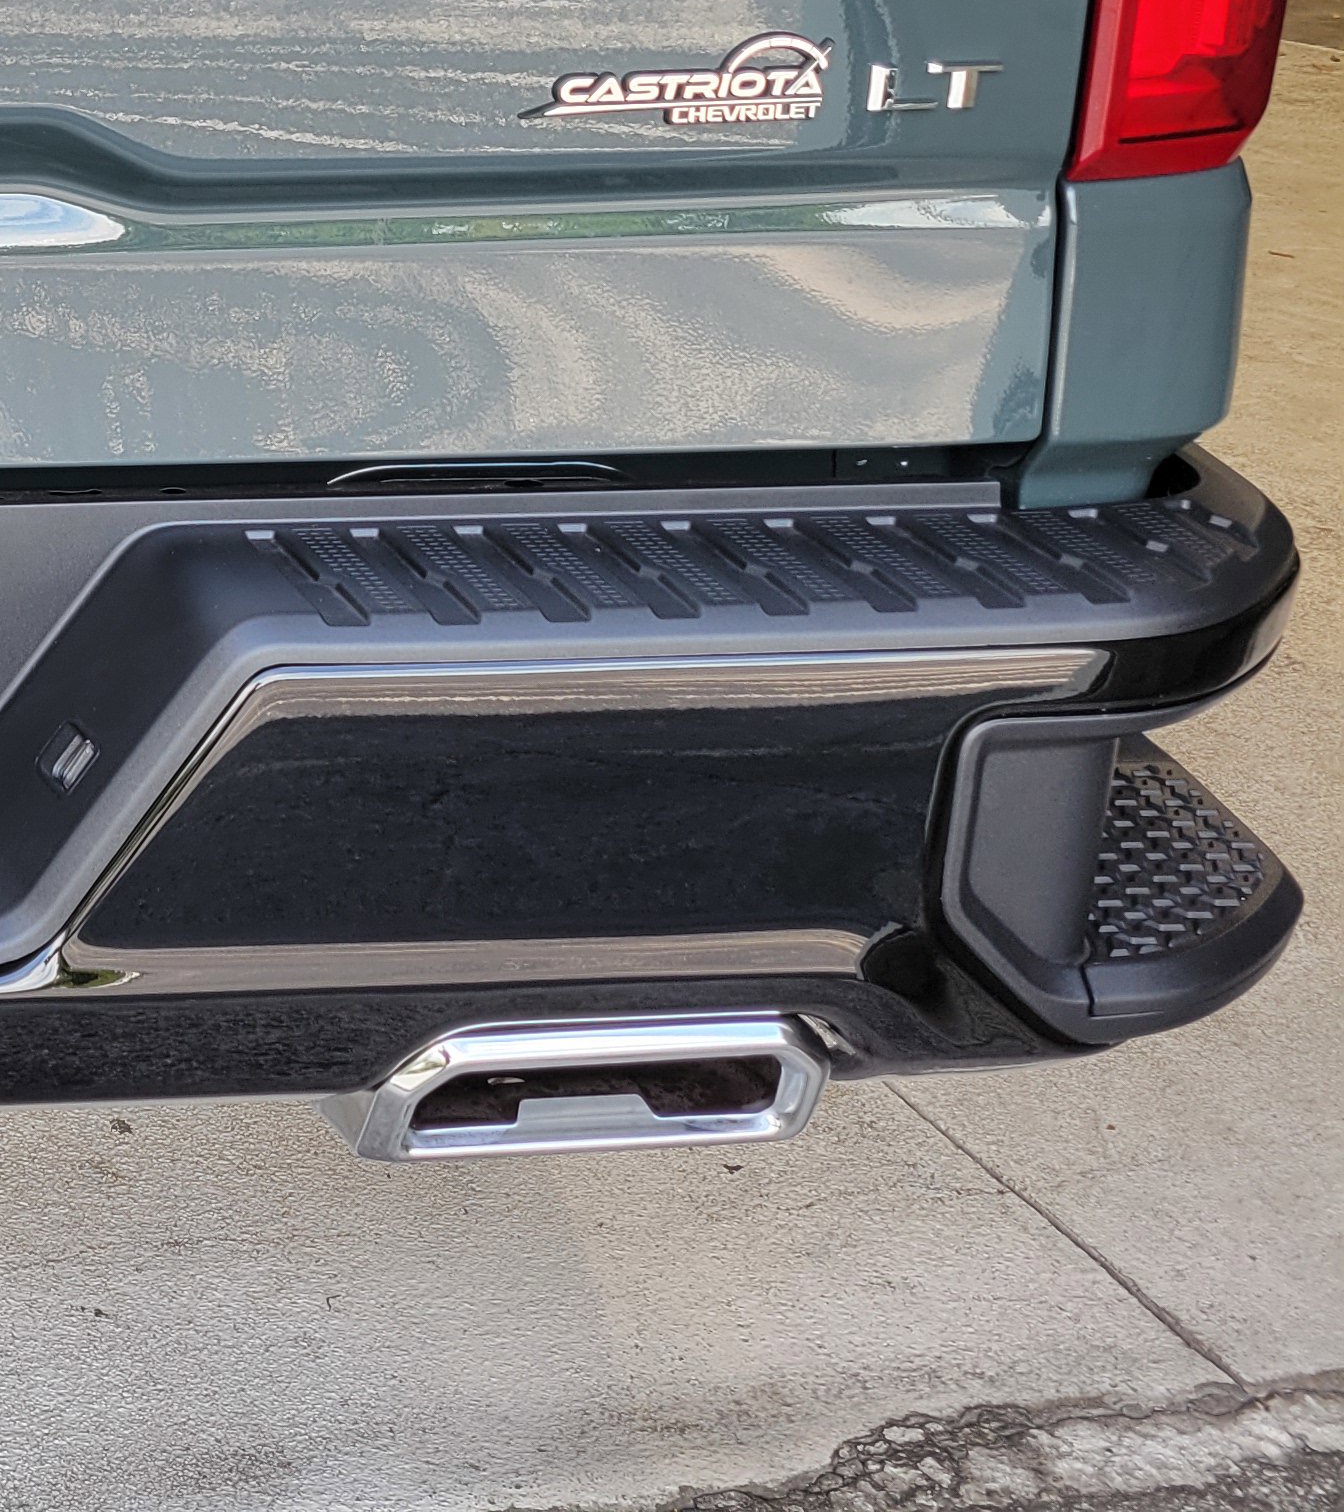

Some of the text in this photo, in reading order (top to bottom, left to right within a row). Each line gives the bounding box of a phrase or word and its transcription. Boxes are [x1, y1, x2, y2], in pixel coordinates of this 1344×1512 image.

[558, 70, 823, 104] CASTRIOTA
[865, 59, 1004, 112] LT
[671, 102, 822, 125] CHEVROLET
